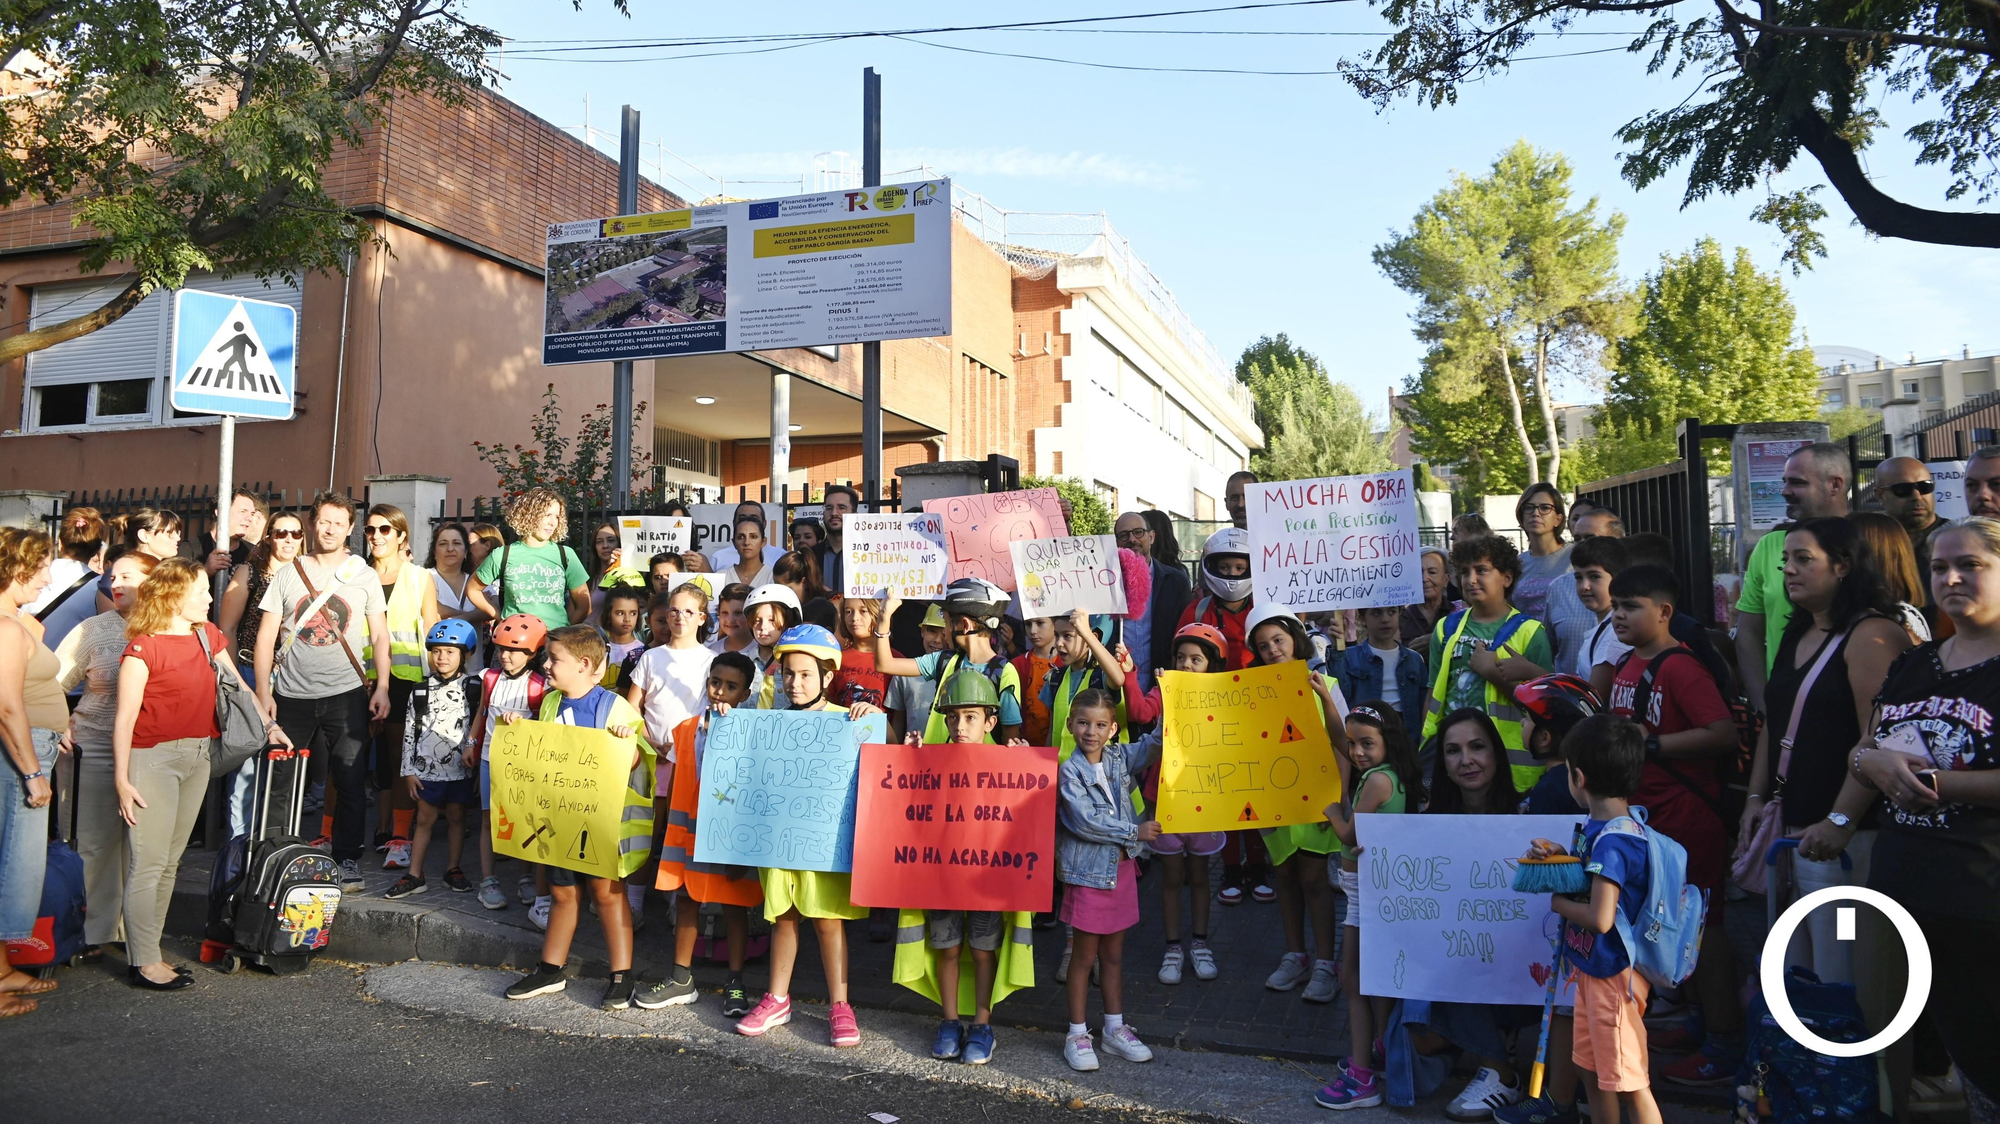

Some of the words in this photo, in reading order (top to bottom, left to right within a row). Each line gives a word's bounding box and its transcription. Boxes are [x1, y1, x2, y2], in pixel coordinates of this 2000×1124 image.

[781, 197, 815, 205] Financiado
[882, 188, 909, 198] AGENDA
[808, 202, 834, 210] Europea
[564, 222, 598, 230] AYUNTAMIENTO
[774, 236, 818, 245] ACCESIBILIDA
[823, 230, 875, 239] CONSERVACIÓN
[554, 335, 599, 343] CONVOCATORIA
[657, 325, 706, 334] REHABILITACIÓN
[681, 331, 722, 339] TRANSPORTE,
[1265, 483, 1349, 513] MUCHA
[1361, 478, 1406, 503] OBRA
[854, 521, 902, 531] PELIGROSO
[907, 521, 926, 532] SEA
[927, 519, 941, 534] NO
[1285, 518, 1317, 533] POCA
[1329, 511, 1397, 529] PREVISIÓN
[649, 531, 677, 541] RATIO
[935, 540, 943, 548] NI
[852, 543, 869, 551] QUE
[876, 540, 928, 552] TORNILLOS
[1027, 538, 1095, 560] QUIERO
[1263, 539, 1328, 572] MALA
[1341, 529, 1414, 560] GESTIÓN
[852, 551, 908, 564] MARTILLOS
[921, 553, 936, 563] SIN
[1024, 559, 1060, 573] USAR
[1076, 549, 1098, 567] MI
[512, 581, 526, 590] DE
[854, 569, 924, 585] ESPACIOSO
[1043, 566, 1116, 594] PATIO
[851, 586, 874, 596] PATIO
[903, 583, 943, 596] QUIERO
[1266, 586, 1278, 602] Y
[1173, 687, 1250, 710] QUEREMOS
[710, 714, 749, 751] EN
[751, 713, 783, 751] MI
[783, 717, 843, 753] COLE
[1169, 718, 1243, 748] COLE
[578, 745, 599, 770] LAS
[505, 762, 535, 783] OBRAS
[542, 773, 548, 785] A
[553, 772, 598, 791] ESTUDIAR
[713, 756, 755, 785] ME
[949, 772, 970, 788] HA
[976, 772, 1049, 791] FALLADO
[508, 787, 525, 806] NO
[536, 795, 550, 809] NOS
[558, 796, 599, 815] AYUDAN
[735, 788, 785, 816] LAS
[905, 804, 933, 821] QUE
[945, 804, 965, 822] LA
[973, 805, 1013, 821] OBRA
[707, 817, 773, 856] NOS
[894, 846, 917, 864] NO
[922, 847, 942, 864] HA
[948, 848, 1039, 880] ACABADO?
[1470, 861, 1507, 889] LA
[1379, 895, 1440, 923] OBRA
[1458, 899, 1529, 922] ACABE
[1442, 929, 1494, 963] YA!!
